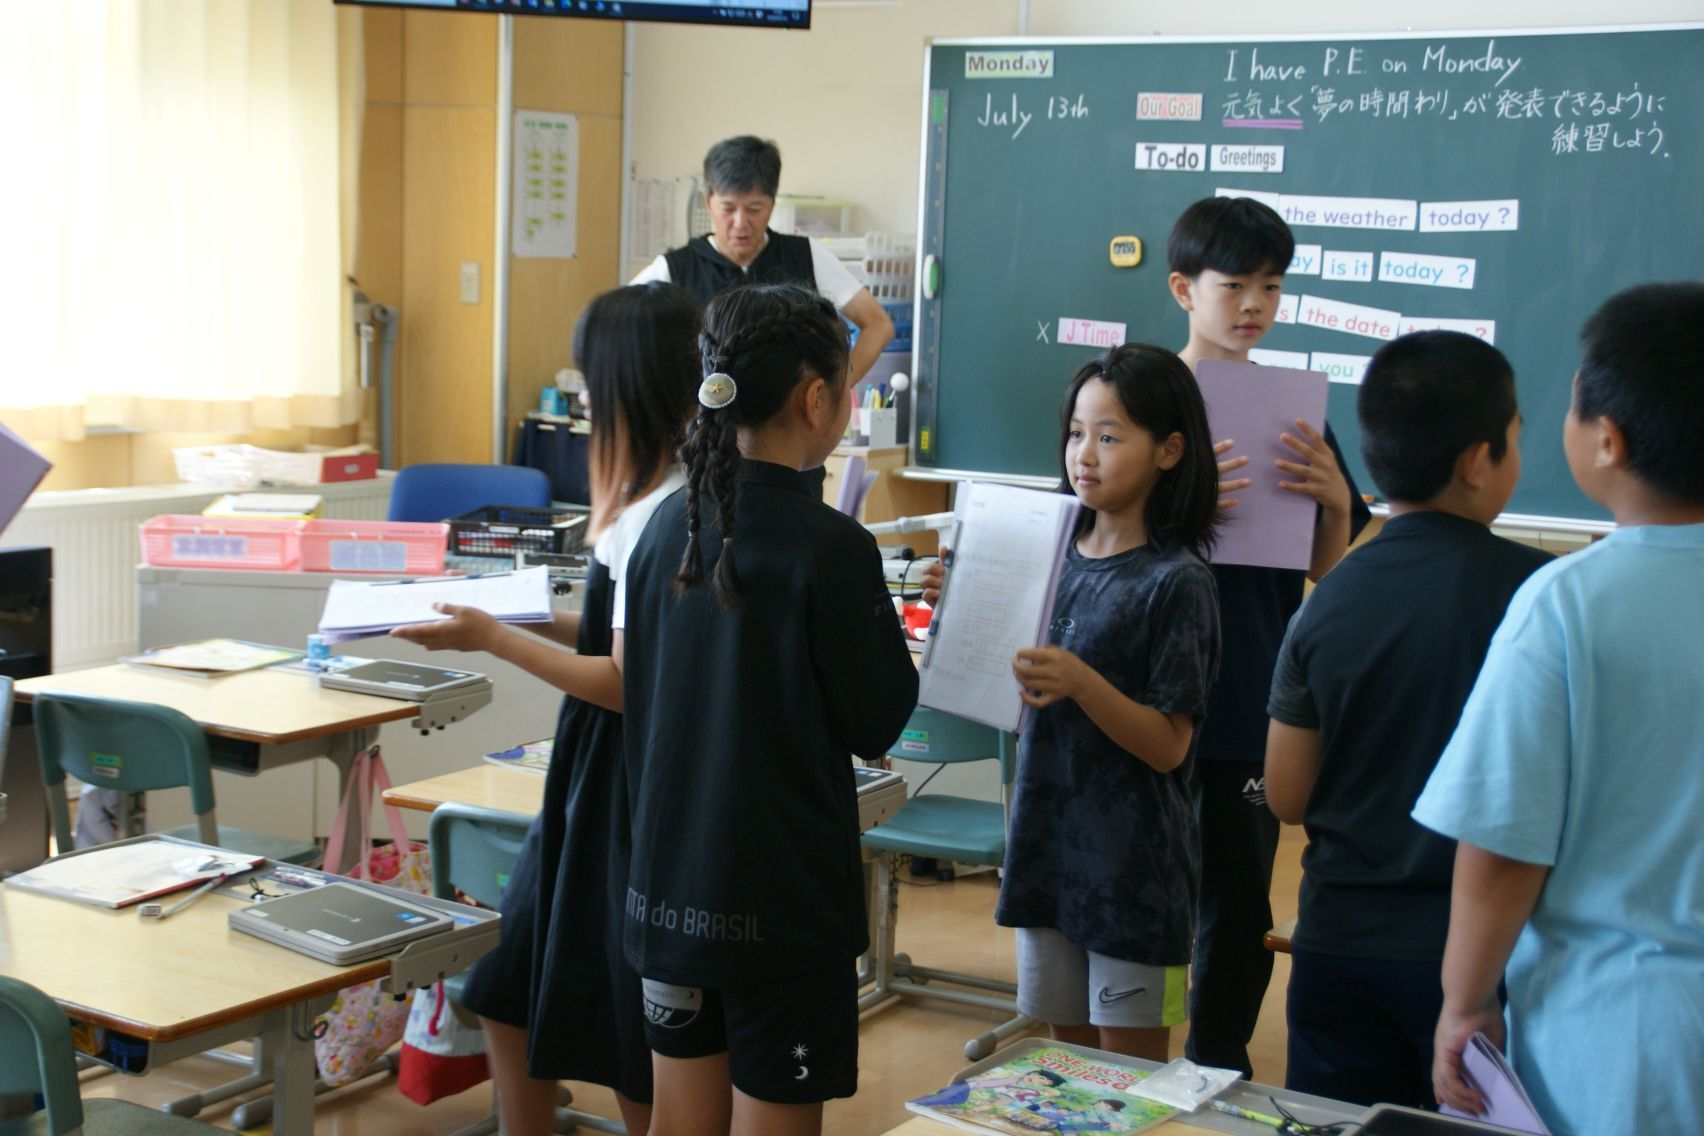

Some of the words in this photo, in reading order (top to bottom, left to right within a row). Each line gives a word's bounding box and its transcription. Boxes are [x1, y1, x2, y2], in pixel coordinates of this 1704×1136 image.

[968, 54, 1050, 75] Monday
[1224, 49, 1239, 81] I
[1250, 48, 1307, 81] have
[1382, 58, 1407, 73] on
[1422, 38, 1522, 87] Monday
[977, 93, 1032, 139] July
[1047, 94, 1089, 120] 13th
[1139, 98, 1164, 117] Our
[1168, 98, 1200, 118] Goal
[1144, 146, 1199, 169] To-do
[1219, 146, 1277, 171] Greetings
[1285, 205, 1317, 225] the
[1323, 209, 1409, 228] weather
[1429, 208, 1490, 230] today
[1498, 207, 1511, 225] ?
[1331, 258, 1347, 276] is
[1353, 258, 1370, 277] it
[1384, 260, 1444, 284] today
[1456, 264, 1470, 284] ?
[1066, 320, 1076, 342] J
[1081, 320, 1120, 345] Time
[1306, 307, 1338, 327] the
[1344, 313, 1392, 338] date
[651, 900, 678, 930] do
[683, 906, 766, 943] BRASIL
